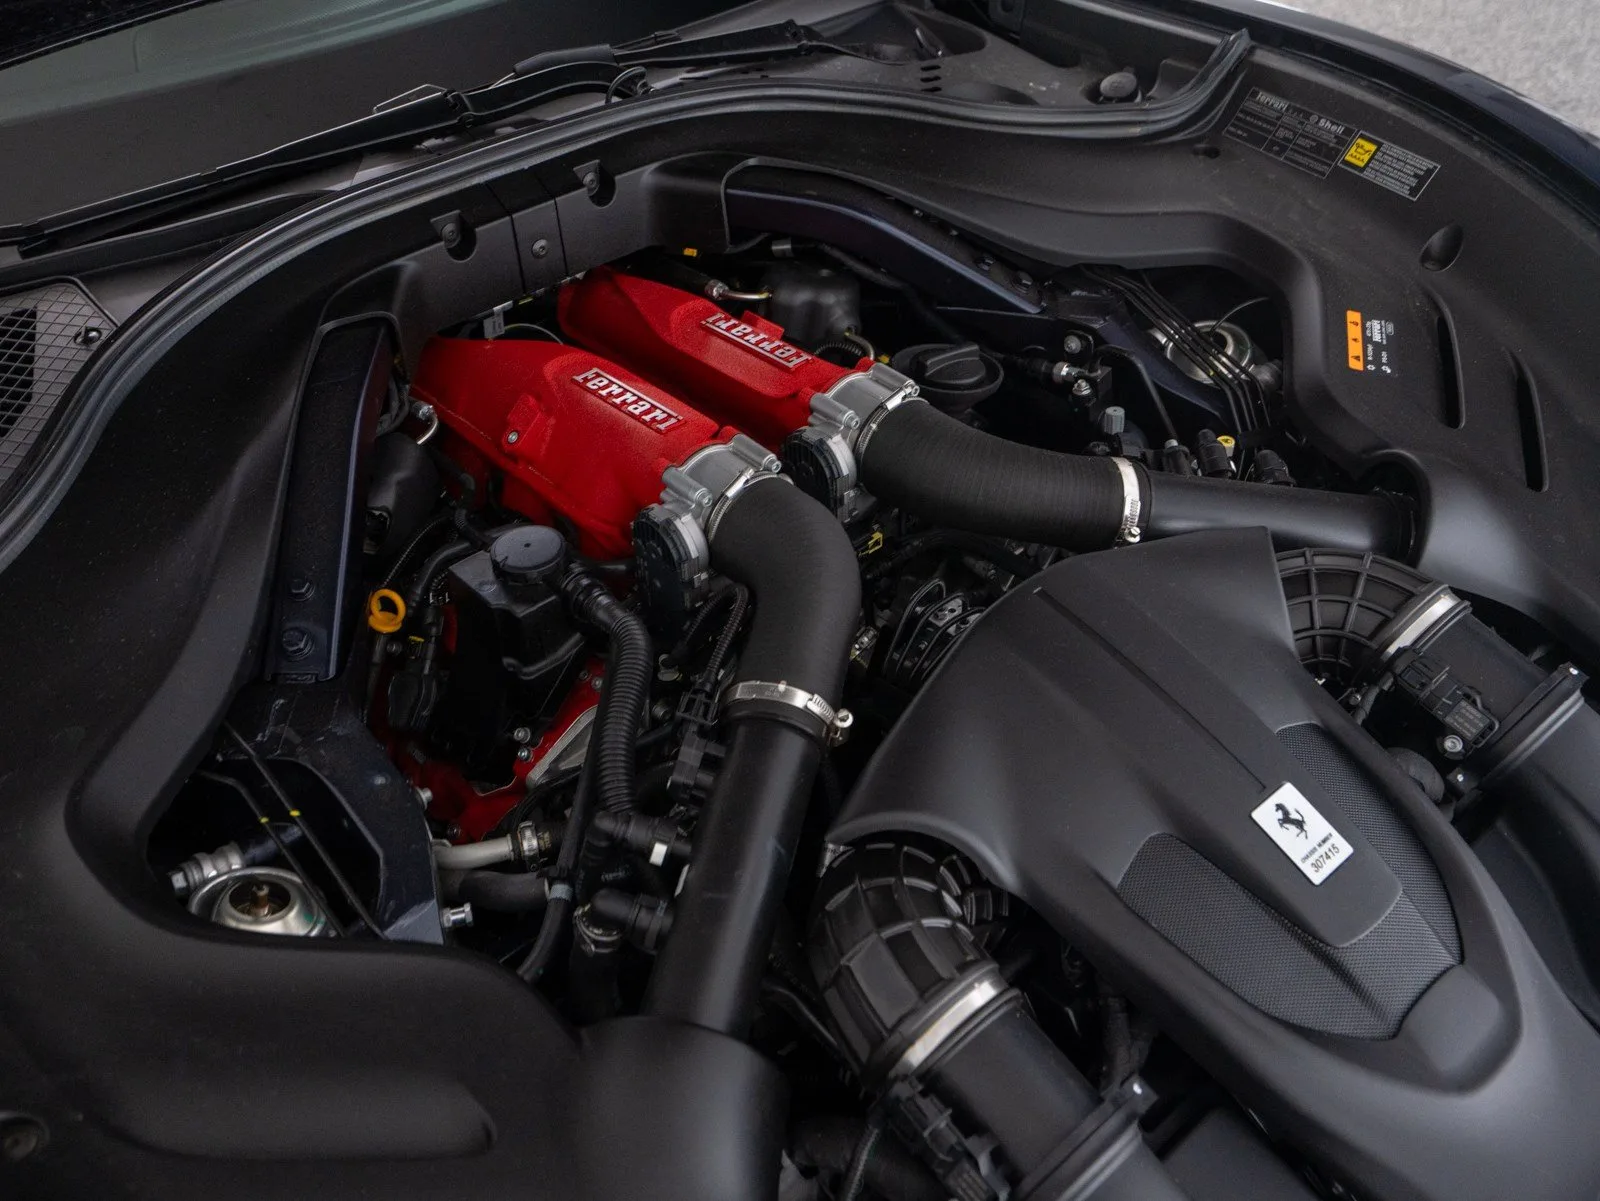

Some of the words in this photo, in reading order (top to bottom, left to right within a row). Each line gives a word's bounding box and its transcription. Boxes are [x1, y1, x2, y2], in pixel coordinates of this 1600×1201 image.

[1318, 118, 1345, 134] Shell
[700, 312, 812, 370] Ferrari
[572, 368, 685, 432] Ferrari
[1310, 843, 1340, 873] 307415
